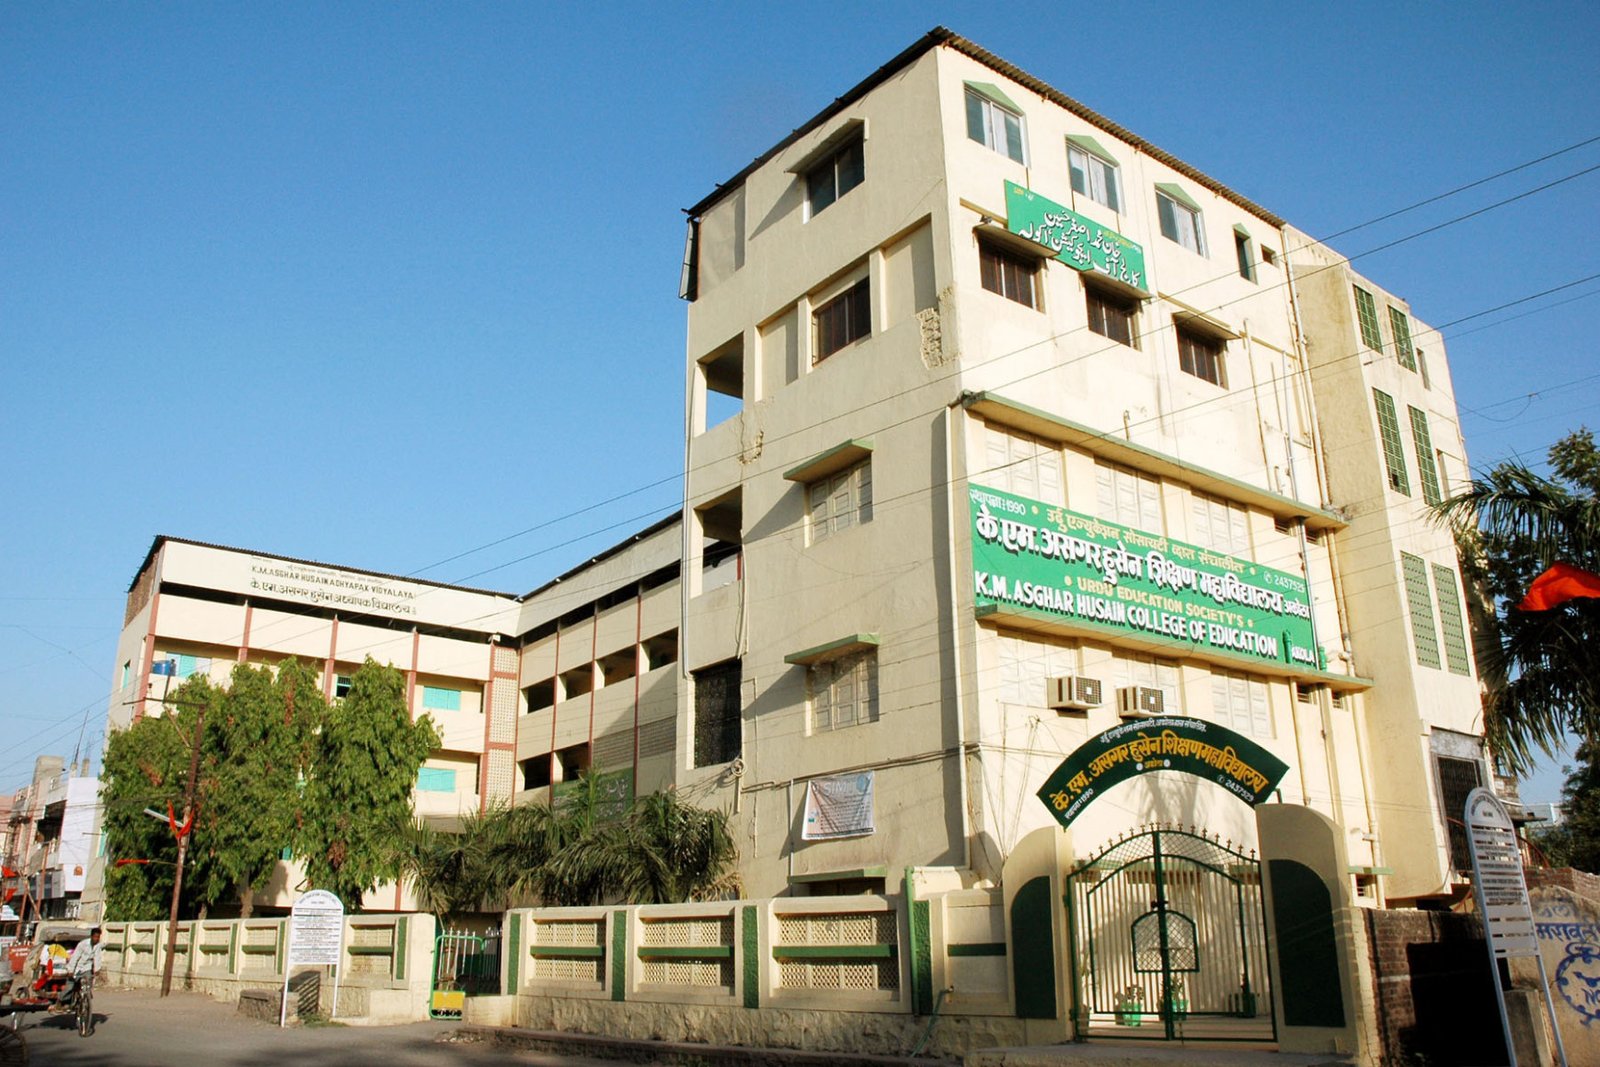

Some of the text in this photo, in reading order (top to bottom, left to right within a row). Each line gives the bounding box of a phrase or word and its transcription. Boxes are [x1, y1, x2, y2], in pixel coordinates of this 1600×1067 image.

[1076, 593, 1126, 624] HUSAIN
[1127, 605, 1187, 638] COLLEGE
[1189, 620, 1206, 643] OF
[1208, 623, 1278, 658] EDUCATION
[1077, 576, 1244, 628] URDU EDUCATION SOCIETY'S
